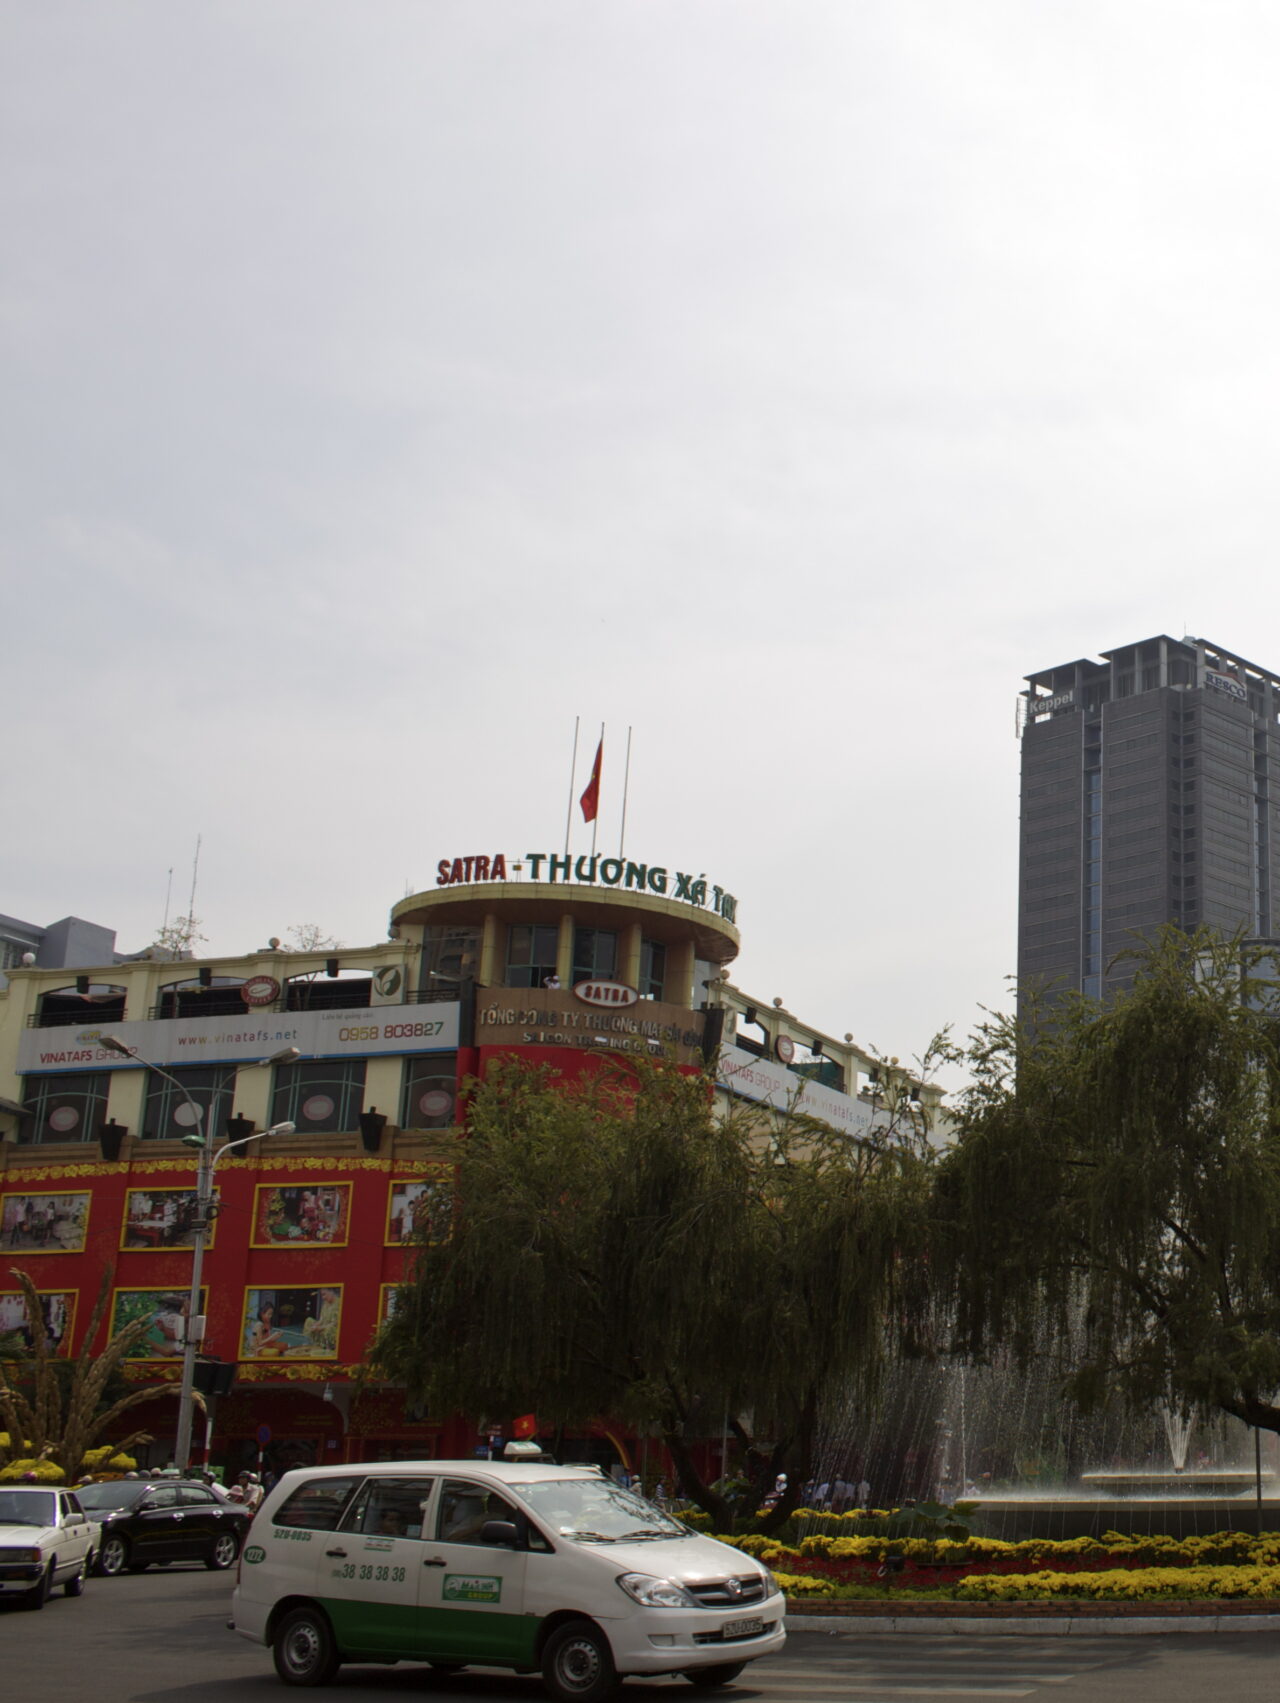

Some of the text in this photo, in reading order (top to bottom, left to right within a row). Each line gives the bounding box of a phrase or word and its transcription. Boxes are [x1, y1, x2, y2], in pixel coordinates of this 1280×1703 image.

[1206, 673, 1246, 698] RESCO
[1029, 689, 1074, 713] Keppel
[437, 854, 506, 885] SATRA
[526, 852, 667, 894] THƯƠNG
[584, 984, 630, 1004] SATRA
[561, 1010, 581, 1028] TY
[178, 1029, 298, 1046] www.vinatafs.net
[339, 1021, 444, 1042] 0958 803827
[39, 1049, 93, 1064] VINATAFS
[719, 1058, 781, 1093] VINATAFS GROUP
[342, 1563, 357, 1579] 38
[359, 1564, 373, 1580] 38
[375, 1565, 390, 1581] 38
[391, 1566, 406, 1582] 38
